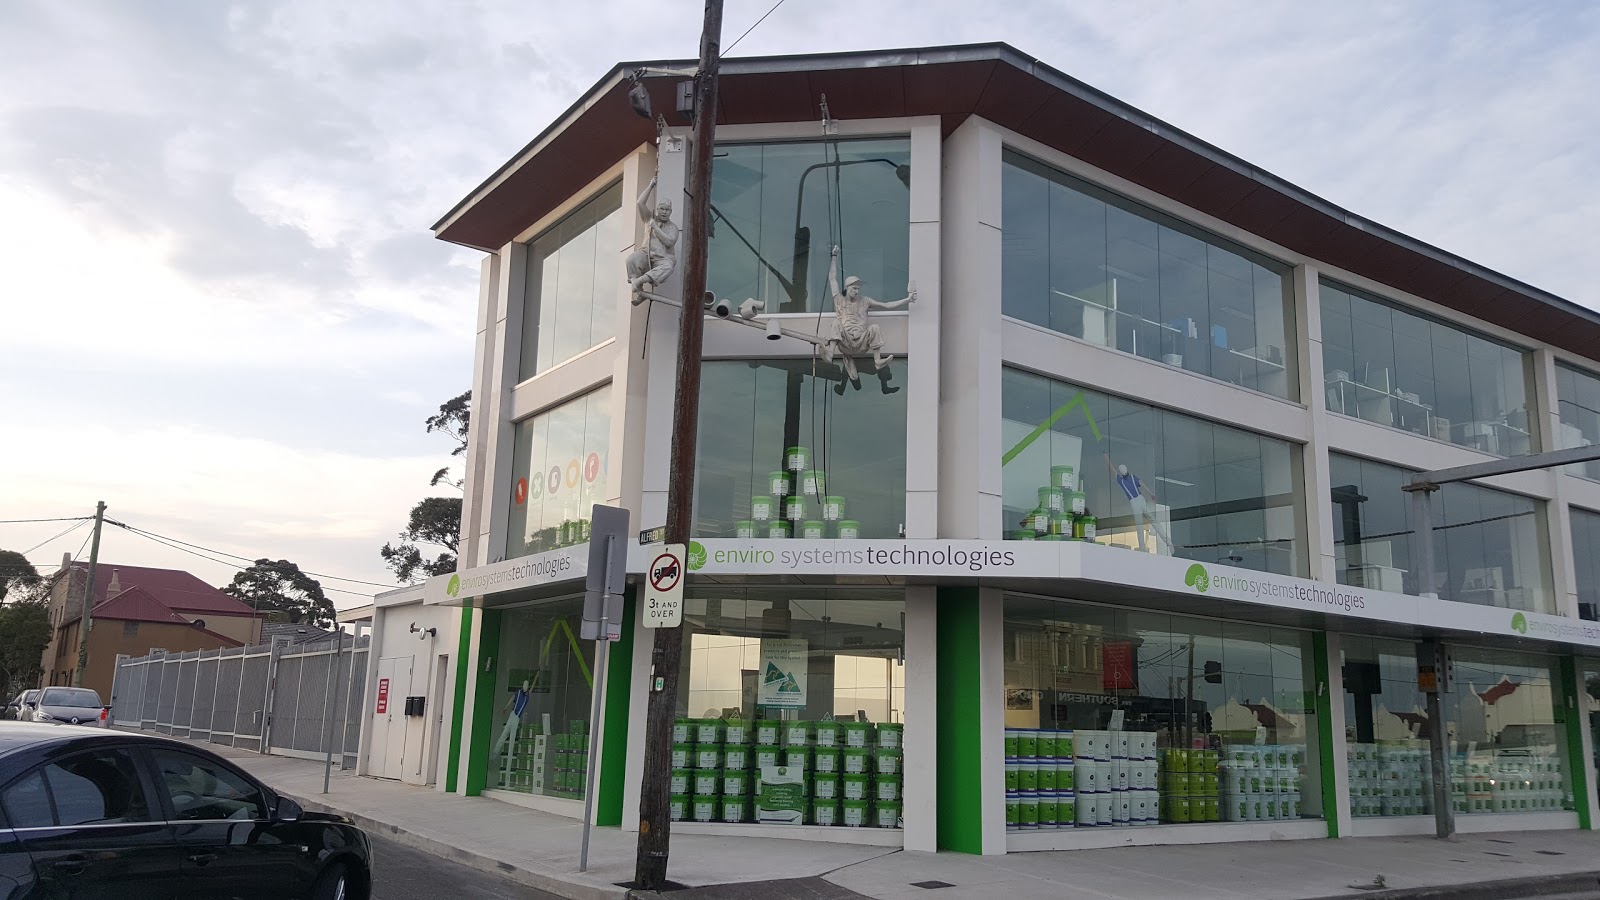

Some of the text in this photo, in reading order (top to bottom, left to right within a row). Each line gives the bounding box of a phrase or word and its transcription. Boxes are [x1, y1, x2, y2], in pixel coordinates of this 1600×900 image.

[641, 530, 659, 543] ALFRED
[714, 545, 1015, 571] enviro systems technologies
[651, 610, 674, 618] OVER
